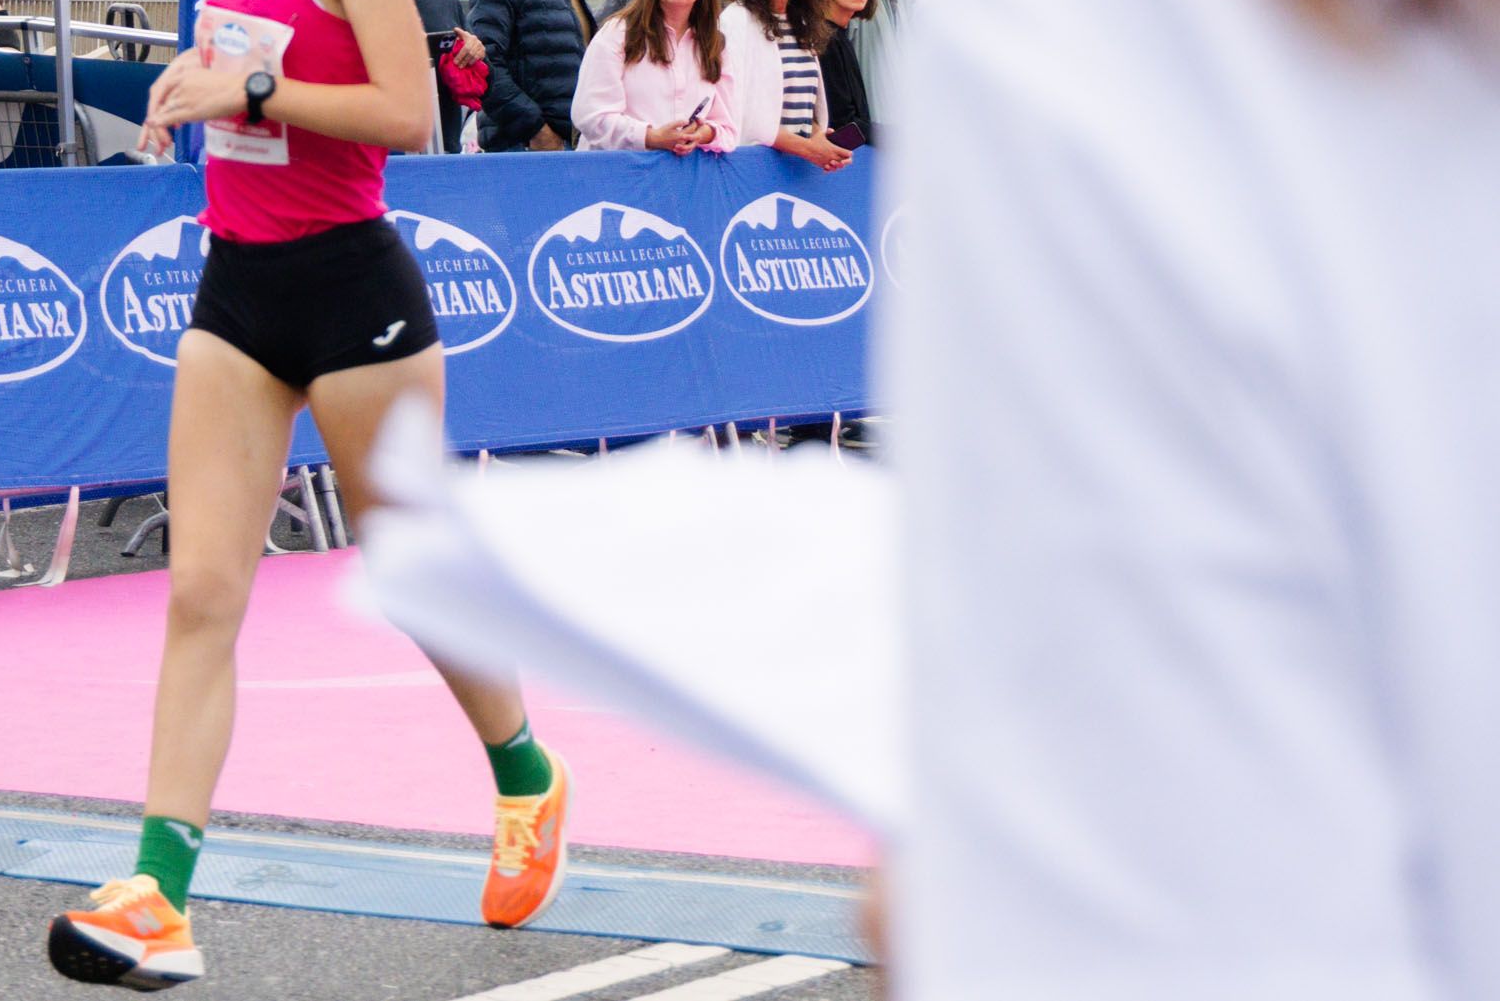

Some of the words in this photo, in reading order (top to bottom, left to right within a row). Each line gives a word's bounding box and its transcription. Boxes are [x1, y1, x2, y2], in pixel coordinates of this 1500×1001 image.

[750, 237, 800, 252] CENTRAL
[802, 236, 852, 251] LECHERA
[426, 258, 490, 274] LECHERA
[565, 248, 627, 267] CENTRAL
[737, 241, 867, 294] ASTURIANA
[548, 256, 705, 311] ASTURIANA
